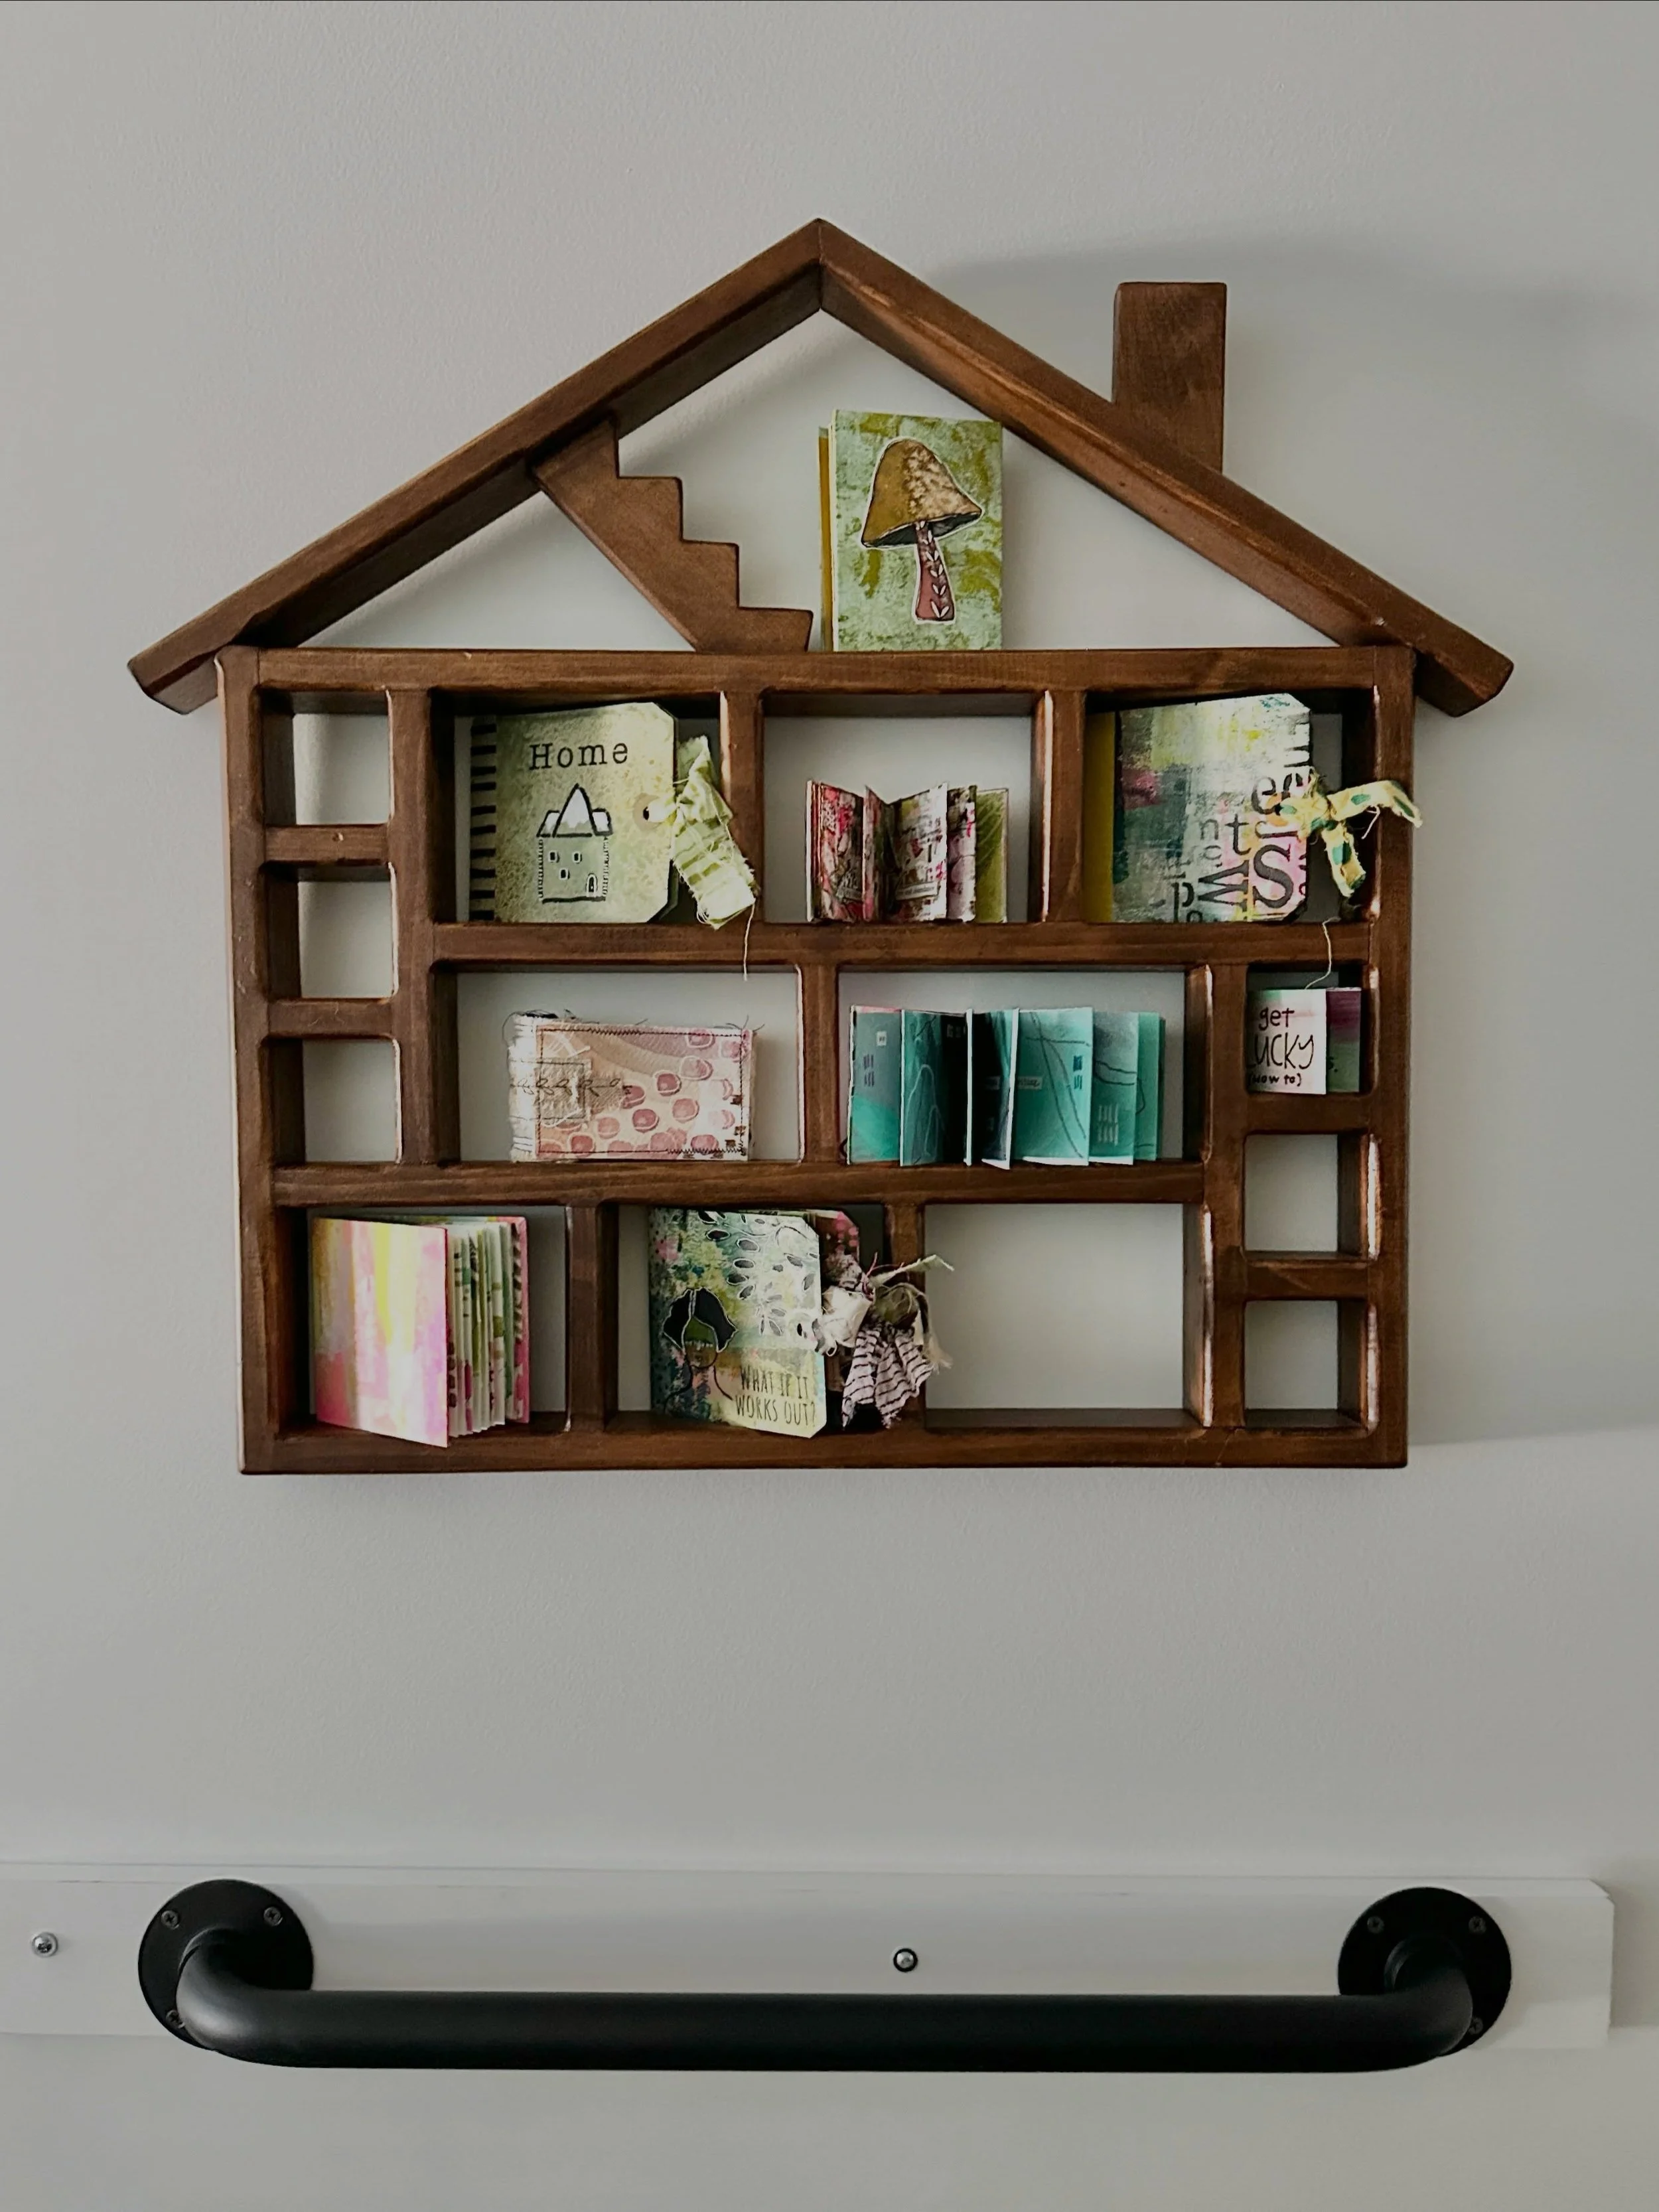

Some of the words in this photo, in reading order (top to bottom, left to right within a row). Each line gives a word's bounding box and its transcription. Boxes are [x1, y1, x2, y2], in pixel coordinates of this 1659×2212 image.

[528, 742, 628, 771] Home
[1258, 1006, 1295, 1031] get
[740, 1366, 773, 1394] WHAT
[780, 1372, 792, 1397] IF
[797, 1375, 808, 1399] IT
[735, 1394, 778, 1422] WORKS
[784, 1401, 816, 1427] OUT?
